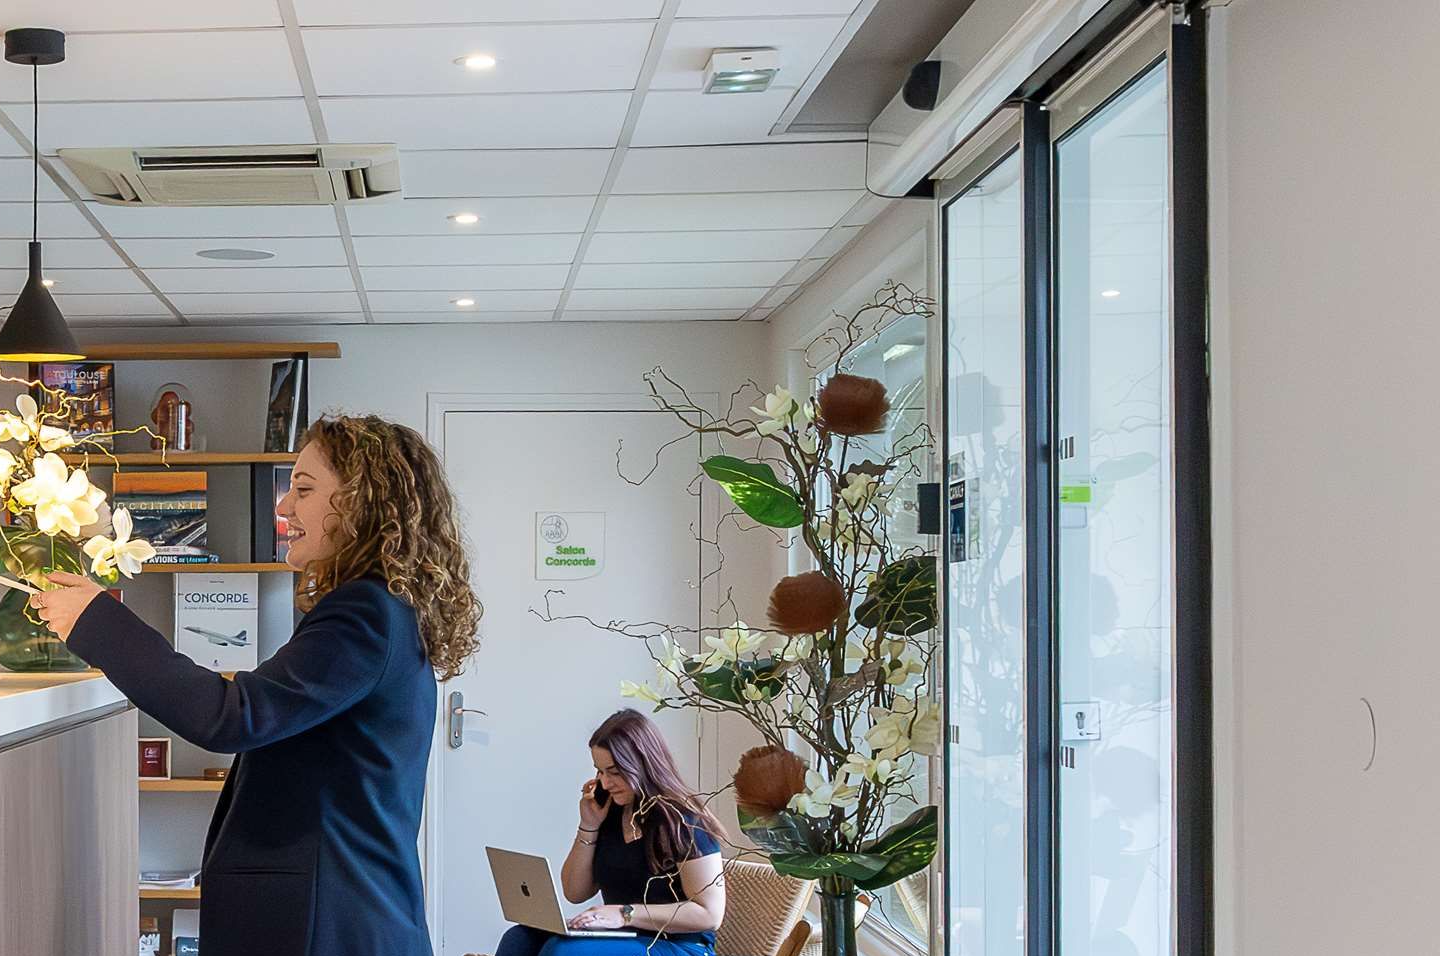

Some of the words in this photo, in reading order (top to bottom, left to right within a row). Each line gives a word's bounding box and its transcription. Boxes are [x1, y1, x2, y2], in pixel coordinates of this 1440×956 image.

[53, 369, 106, 381] TOULOUSE
[117, 502, 207, 510] OCCITANIE
[555, 545, 586, 555] Salon
[149, 555, 178, 564] AVIONS
[545, 557, 597, 566] Concorde
[184, 592, 249, 603] CONCORDE
